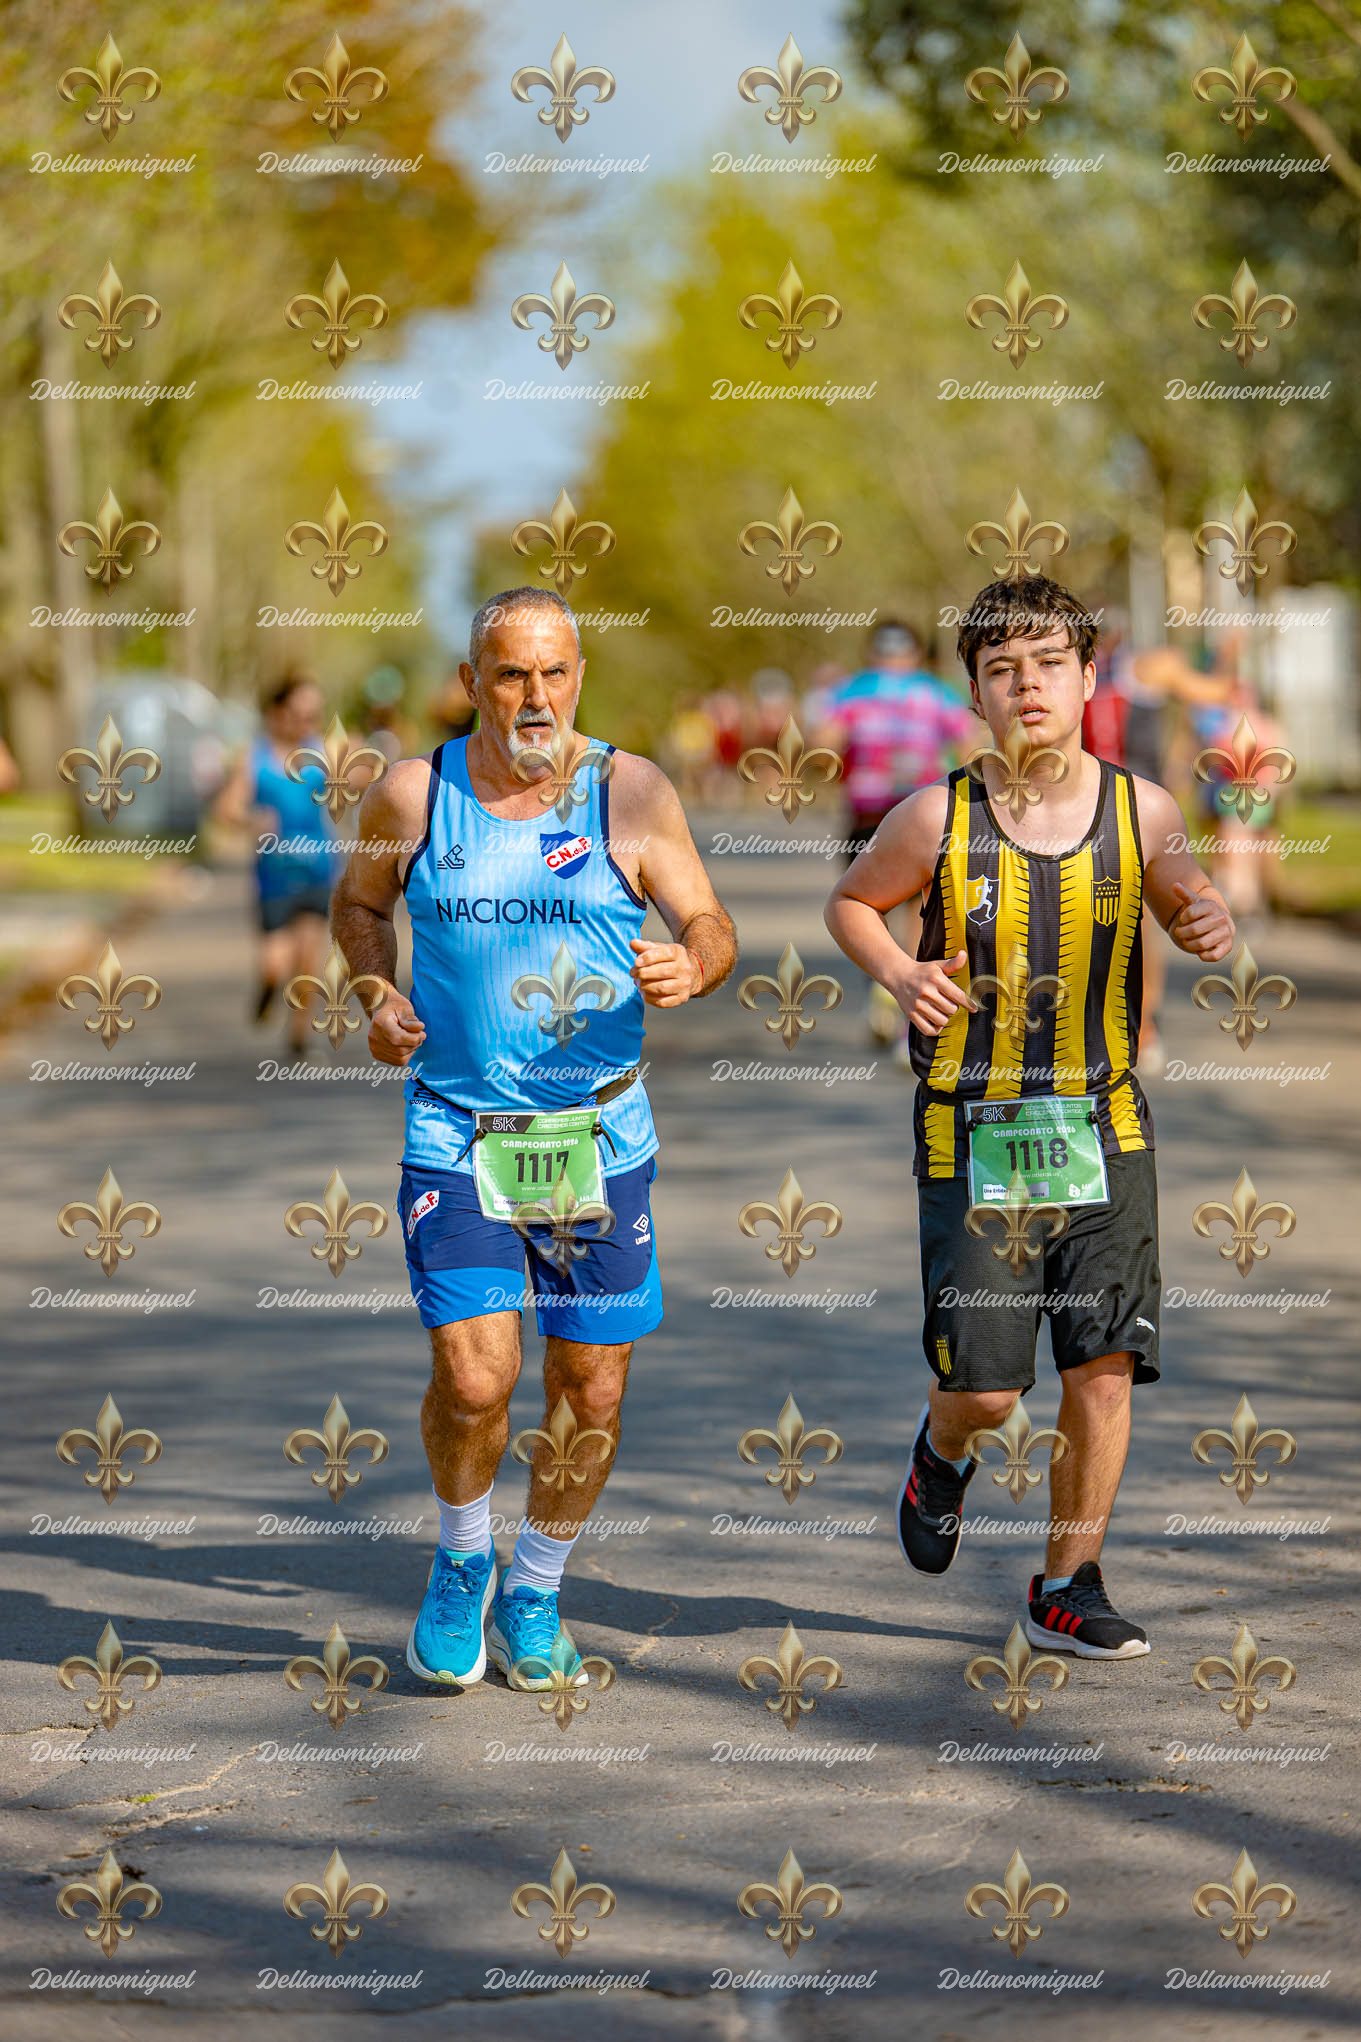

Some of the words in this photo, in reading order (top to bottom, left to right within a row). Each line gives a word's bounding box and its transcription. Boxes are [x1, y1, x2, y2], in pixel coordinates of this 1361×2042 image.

[436, 898, 581, 924] NACIONAL
[983, 1106, 1006, 1122] 5K
[492, 1117, 517, 1131] 5K
[993, 1127, 1054, 1138] CAMPEONATO
[1056, 1126, 1077, 1134] 2026
[501, 1140, 561, 1149] CAMPEONATO
[1006, 1138, 1069, 1171] 1118
[515, 1151, 569, 1183] 1117
